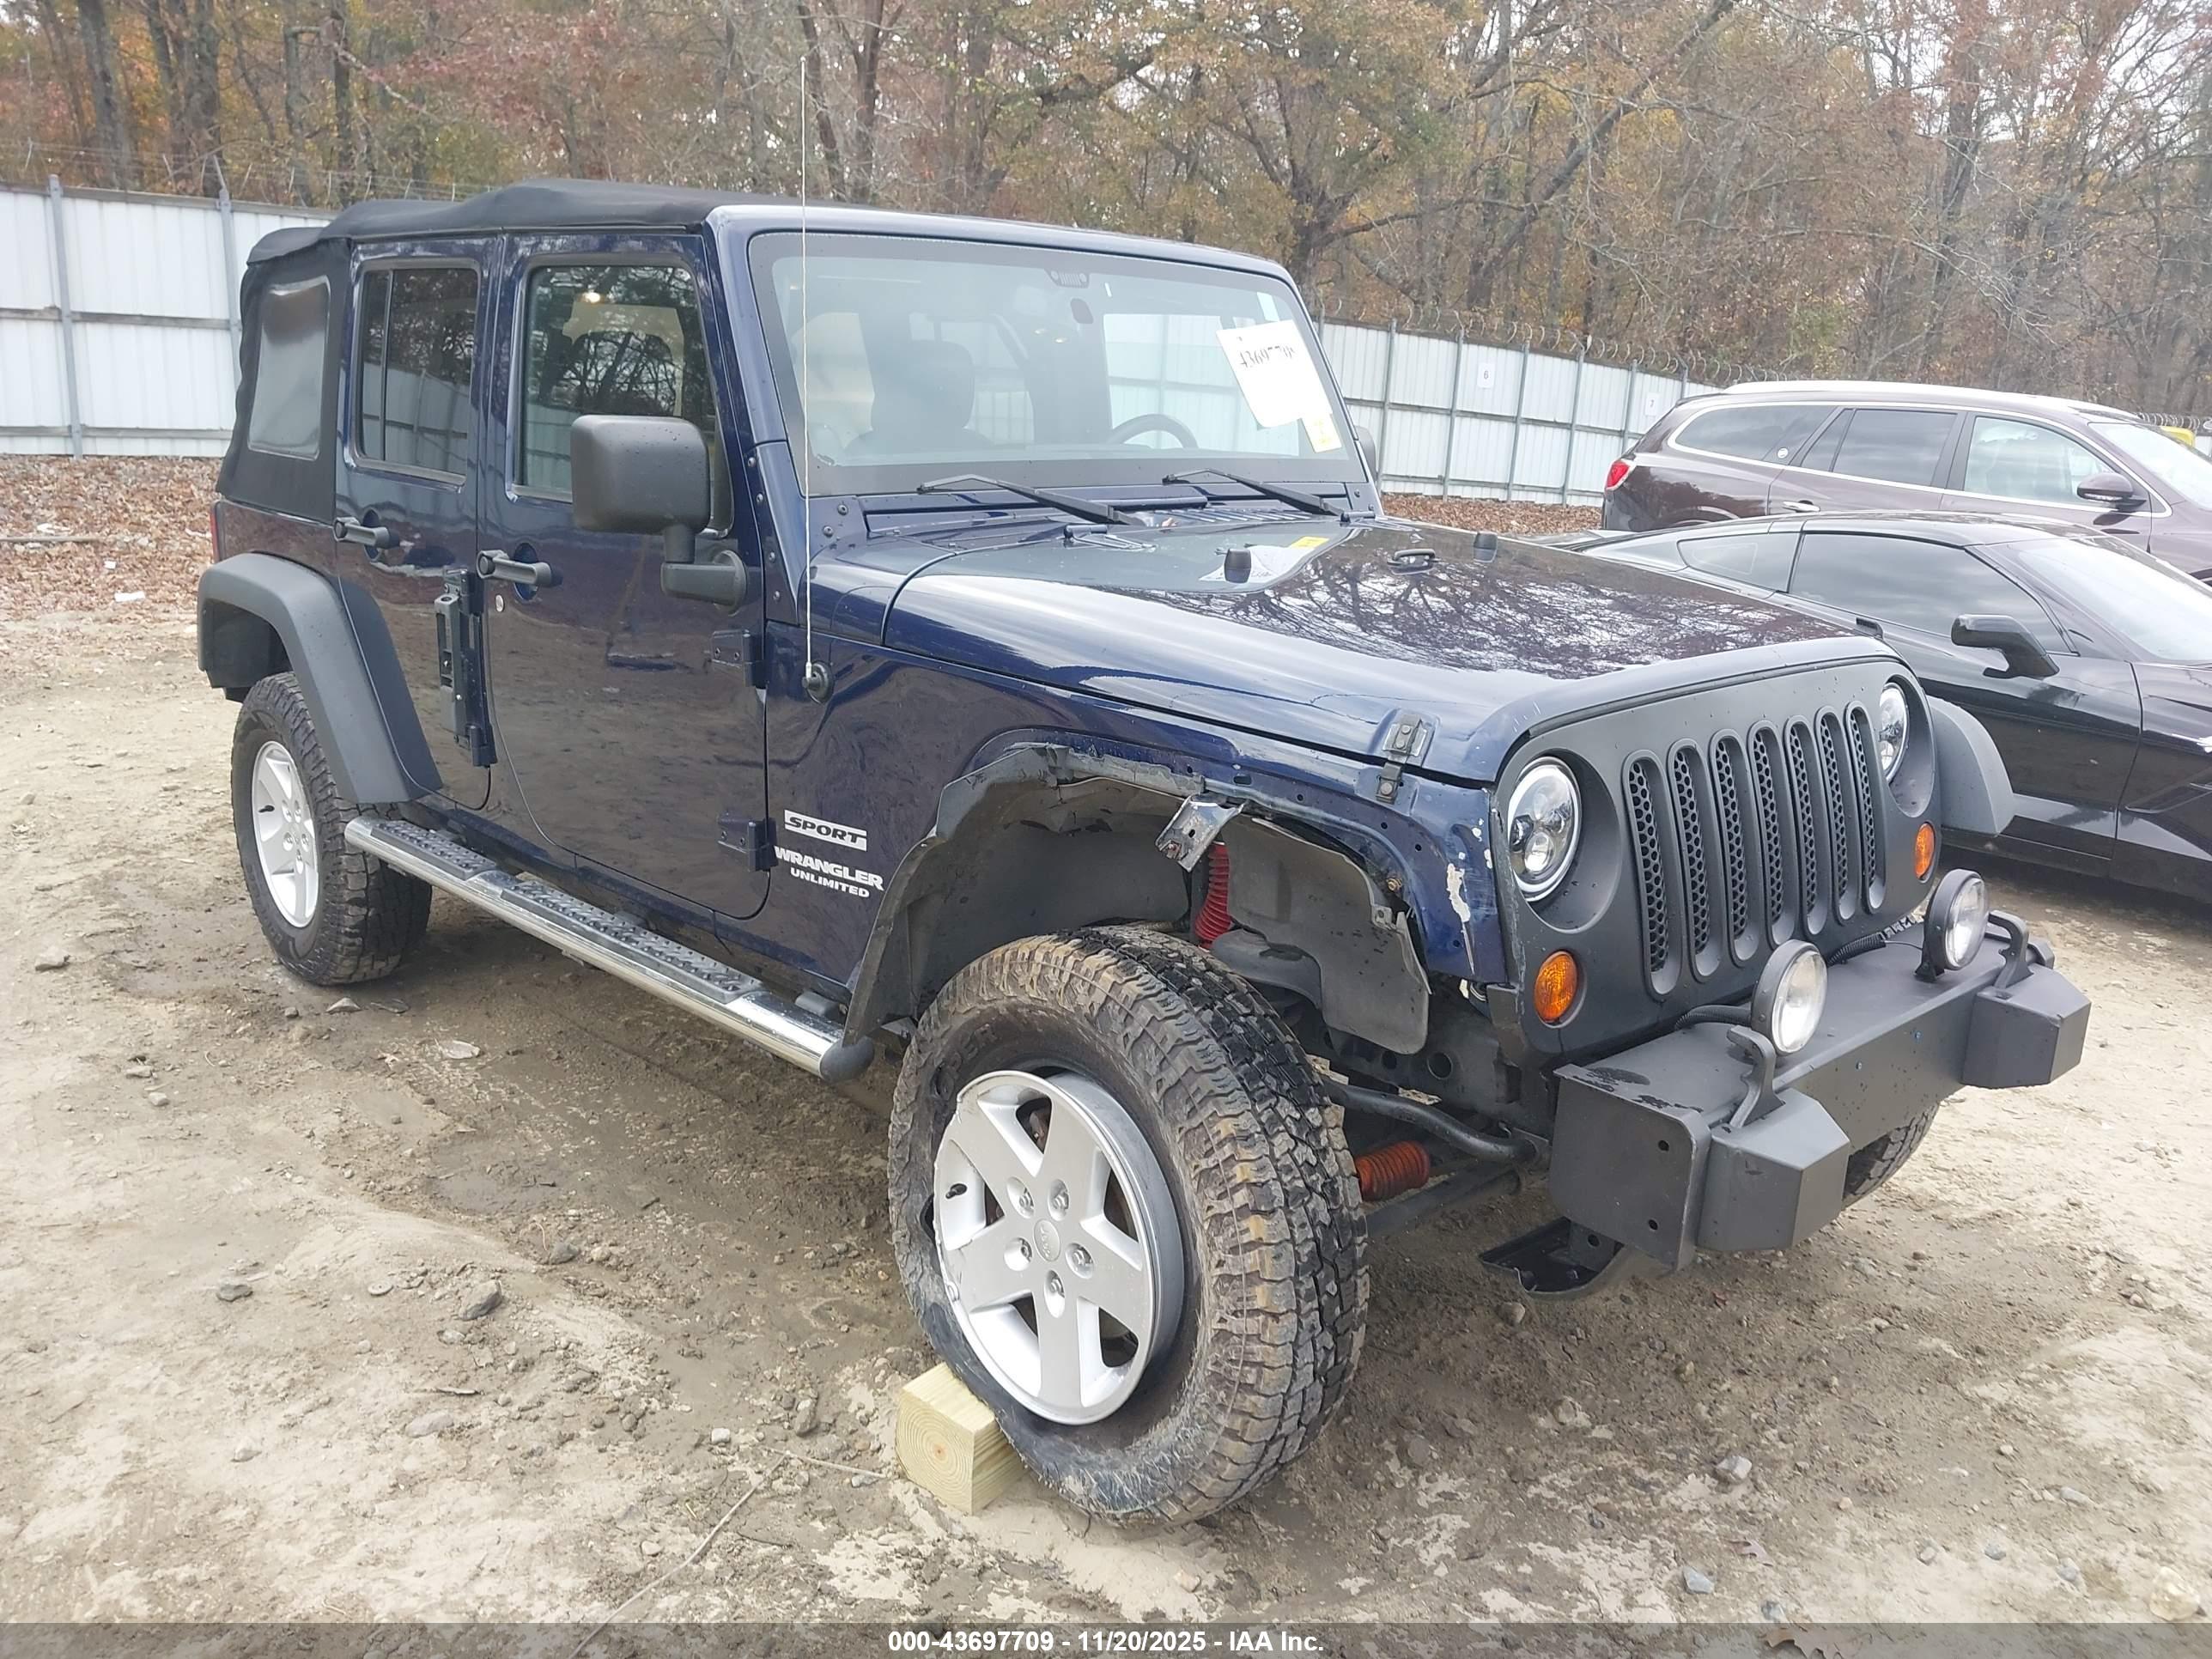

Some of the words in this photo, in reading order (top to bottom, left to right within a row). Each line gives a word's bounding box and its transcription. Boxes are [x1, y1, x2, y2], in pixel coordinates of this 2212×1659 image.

[787, 815, 866, 845] SPORT
[774, 845, 884, 891] WRANGLER
[790, 867, 870, 898] UNLIMITED
